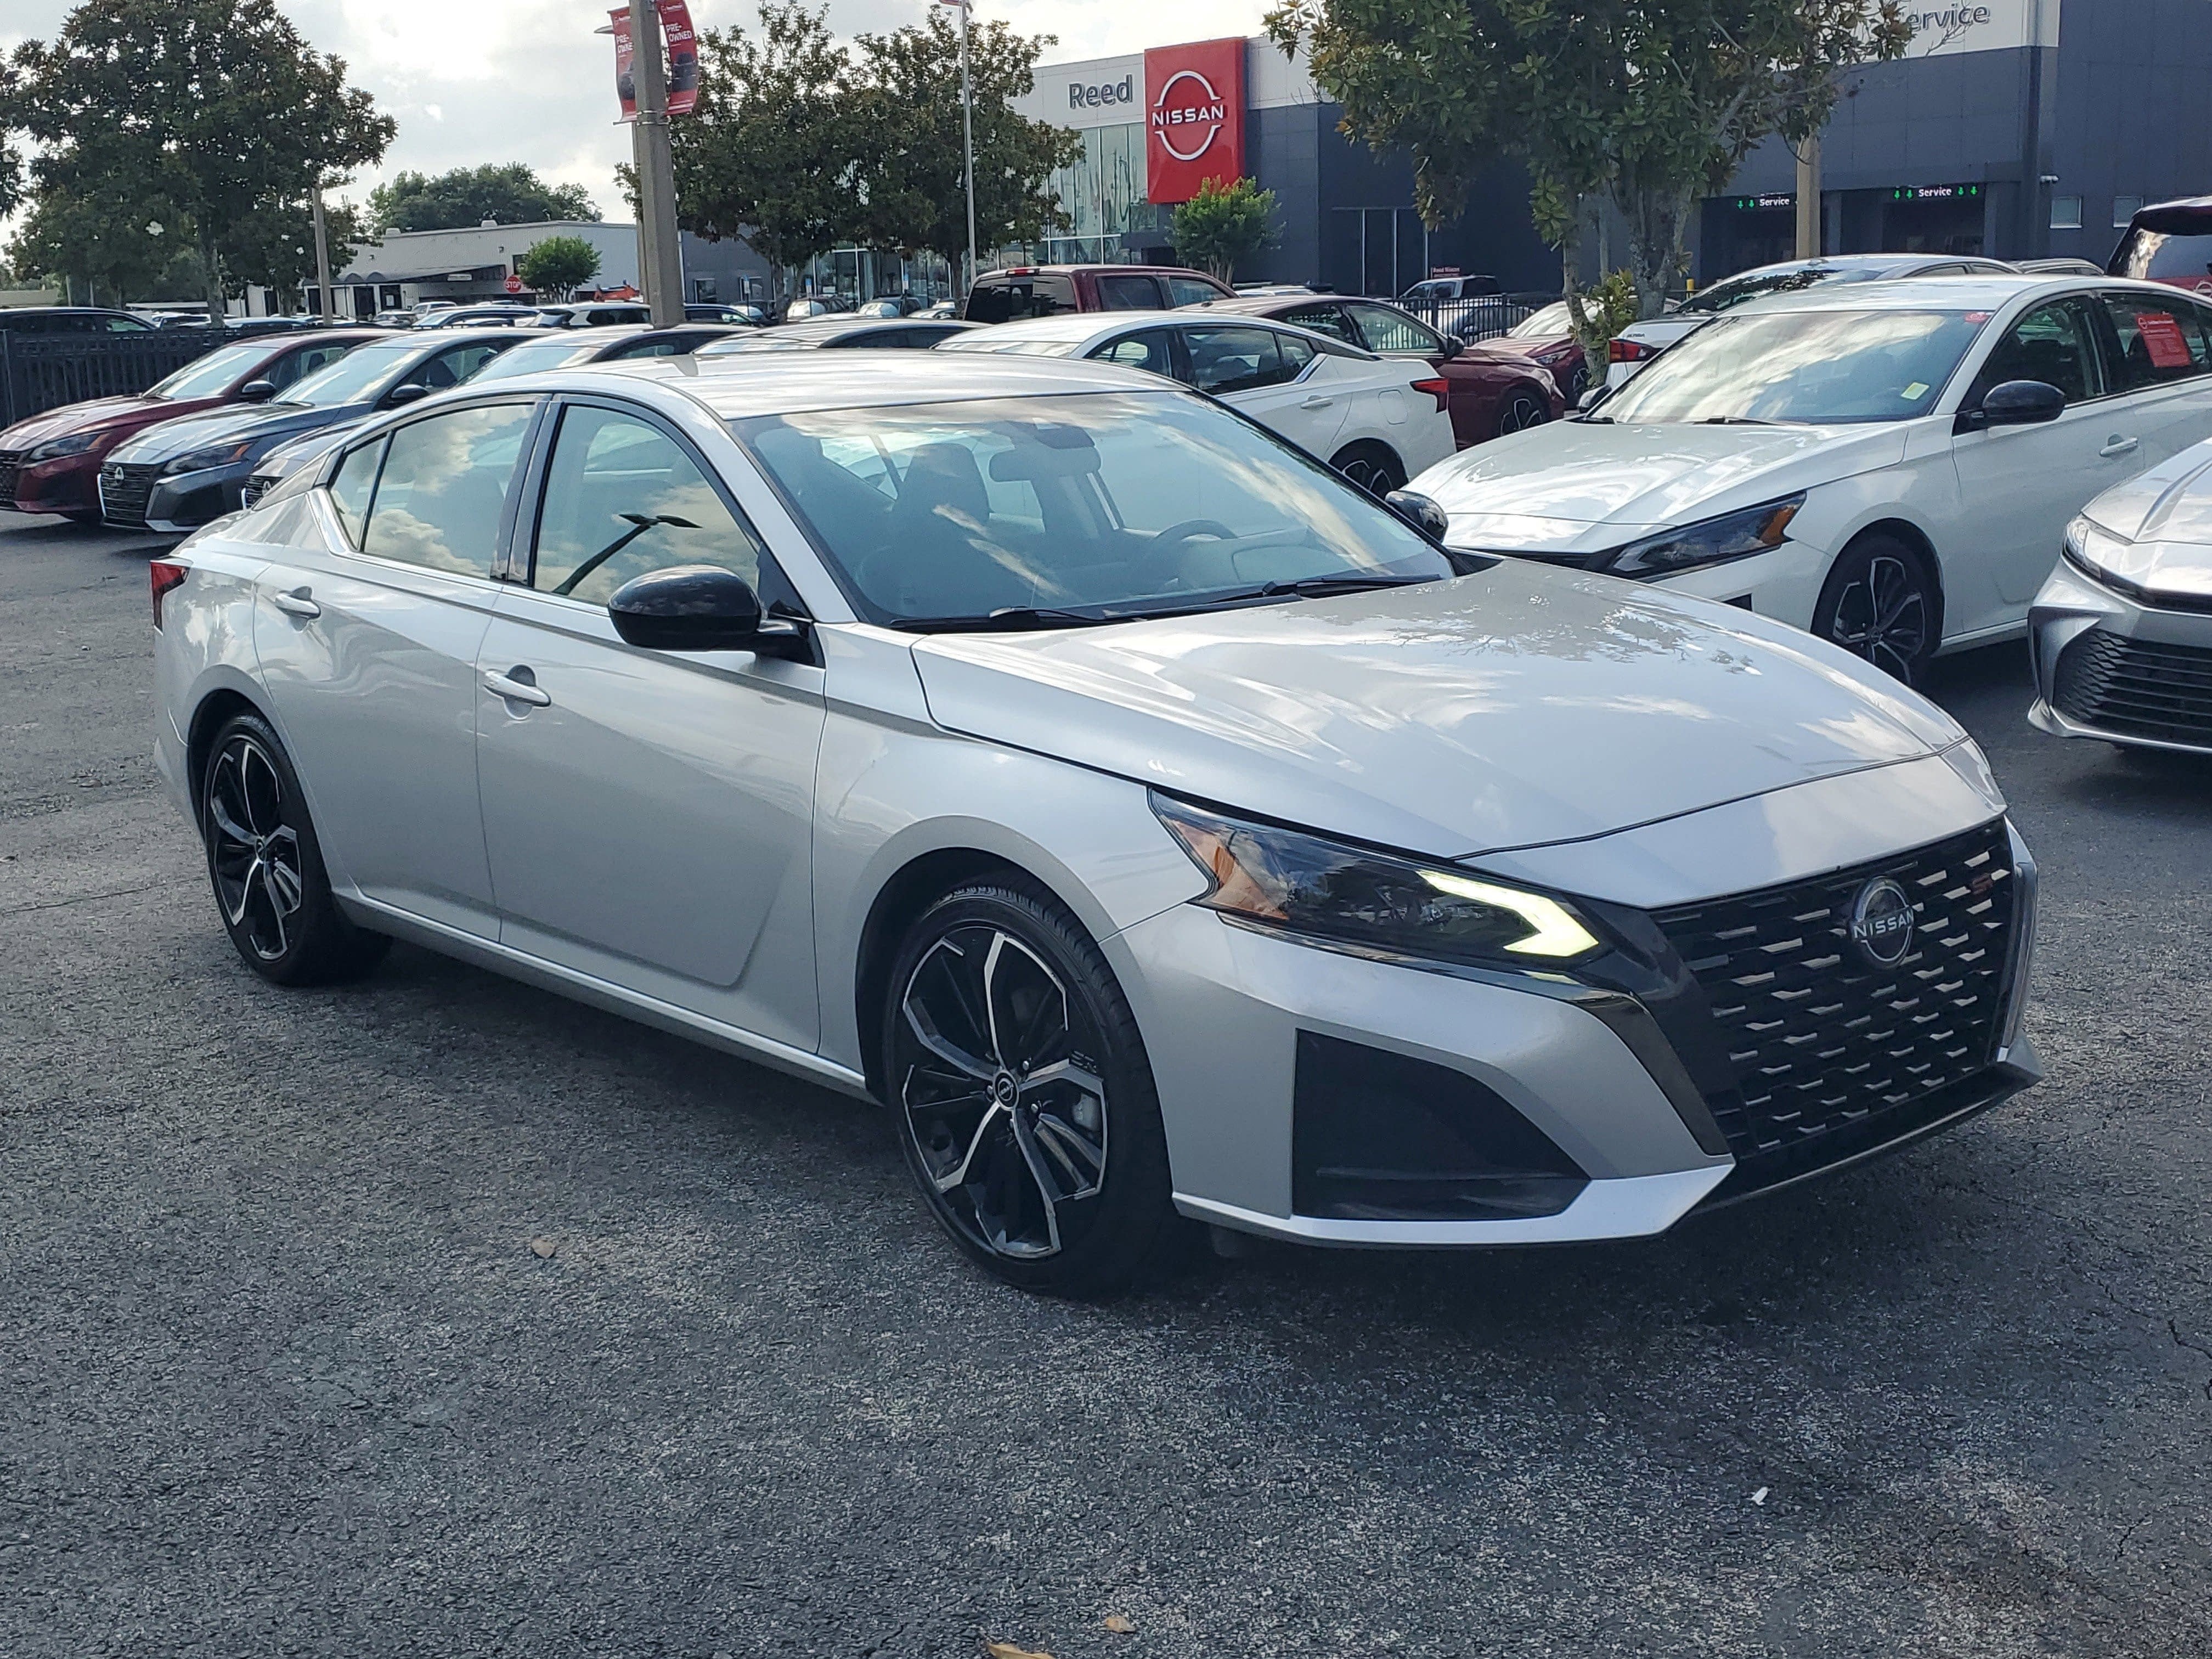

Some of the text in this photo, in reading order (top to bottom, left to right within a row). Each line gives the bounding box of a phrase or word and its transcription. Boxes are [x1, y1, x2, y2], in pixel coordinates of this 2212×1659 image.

[1905, 3, 1989, 31] ervice
[666, 22, 682, 32] PRE-
[669, 30, 692, 42] OWNED
[618, 42, 633, 53] OWNE
[1069, 74, 1133, 109] Reed
[1152, 105, 1224, 126] NISSAN
[1918, 187, 1952, 197] Service
[1759, 198, 1790, 206] Service
[1854, 909, 1914, 939] NISSAN
